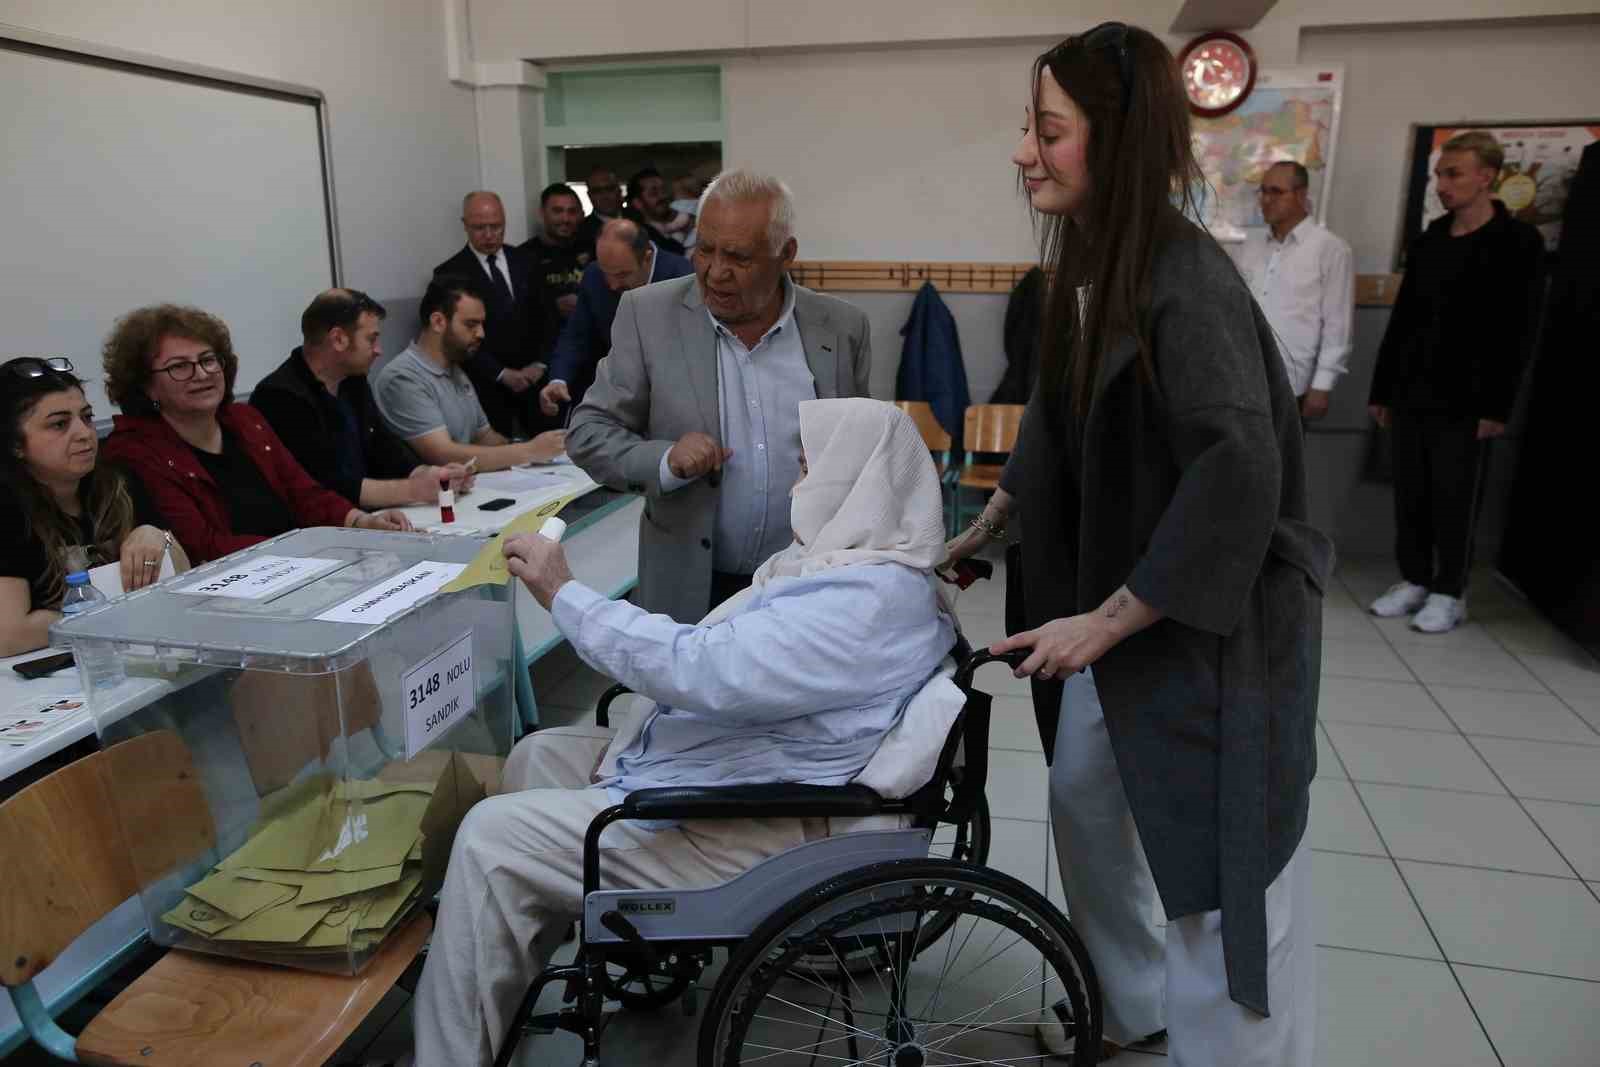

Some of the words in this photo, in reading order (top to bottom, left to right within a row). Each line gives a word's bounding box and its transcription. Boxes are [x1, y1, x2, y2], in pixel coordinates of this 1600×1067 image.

[198, 574, 249, 592] 3148
[408, 673, 440, 710] 3148
[446, 656, 471, 685] NOLU
